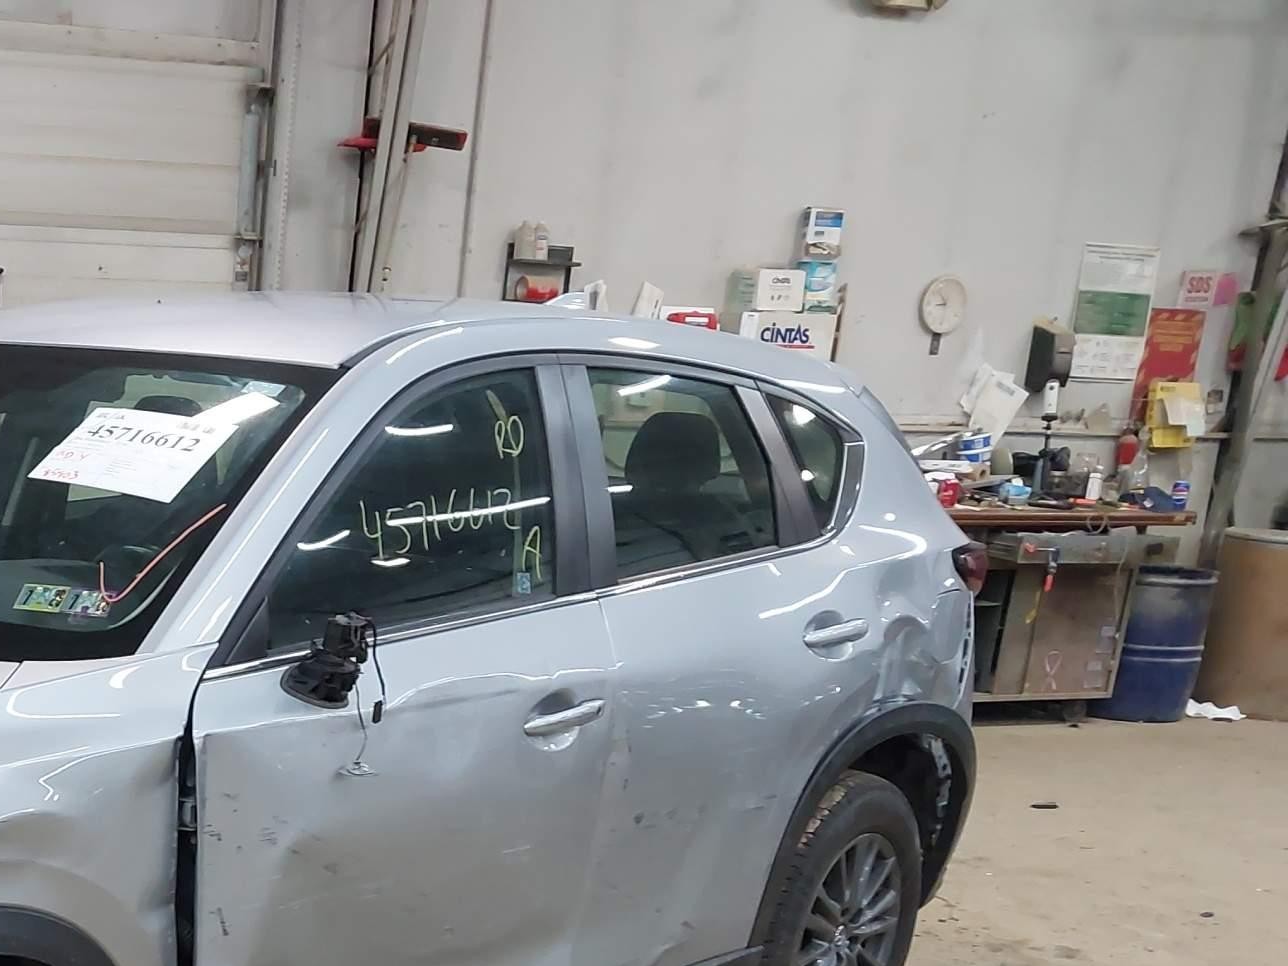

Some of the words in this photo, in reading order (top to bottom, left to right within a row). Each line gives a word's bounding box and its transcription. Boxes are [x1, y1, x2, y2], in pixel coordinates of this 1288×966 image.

[1187, 275, 1213, 294] SDS
[760, 321, 810, 344] CINTAS
[87, 424, 201, 452] 45716612
[359, 487, 520, 560] 45716612
[523, 526, 542, 579] A
